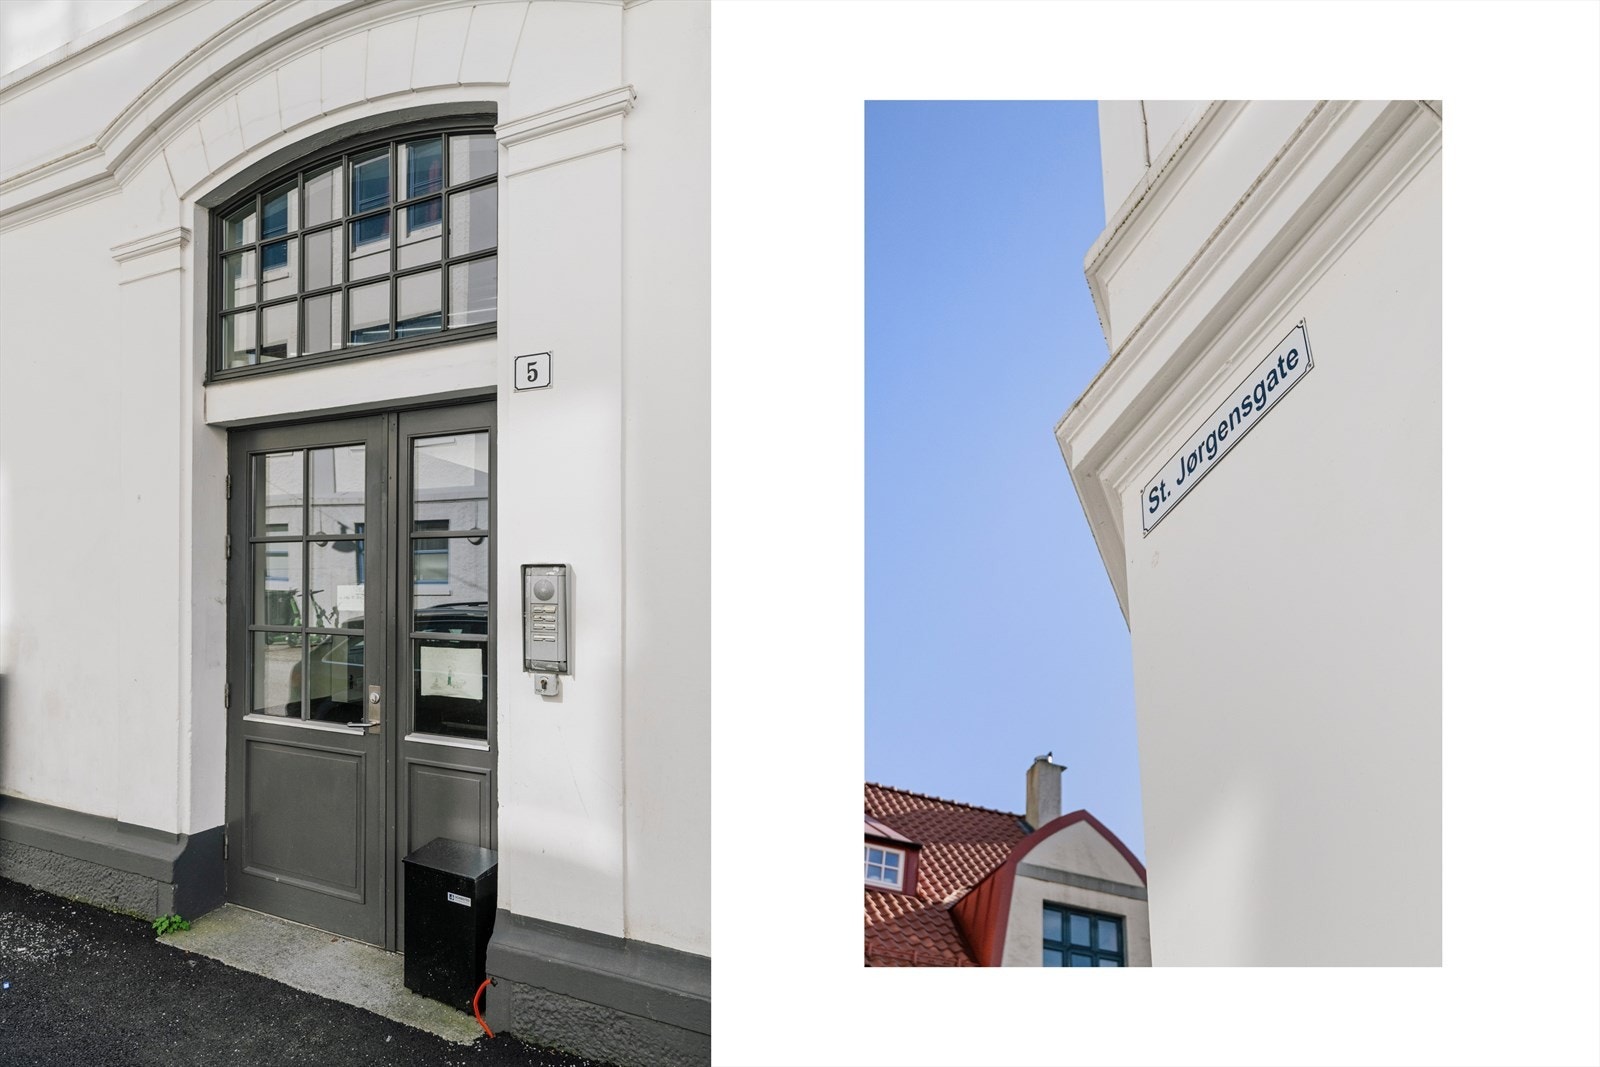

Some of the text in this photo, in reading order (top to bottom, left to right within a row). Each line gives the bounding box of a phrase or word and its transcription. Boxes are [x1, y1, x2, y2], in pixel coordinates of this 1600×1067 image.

[527, 361, 538, 382] 5
[1149, 348, 1299, 514] St. Jørgensgate
